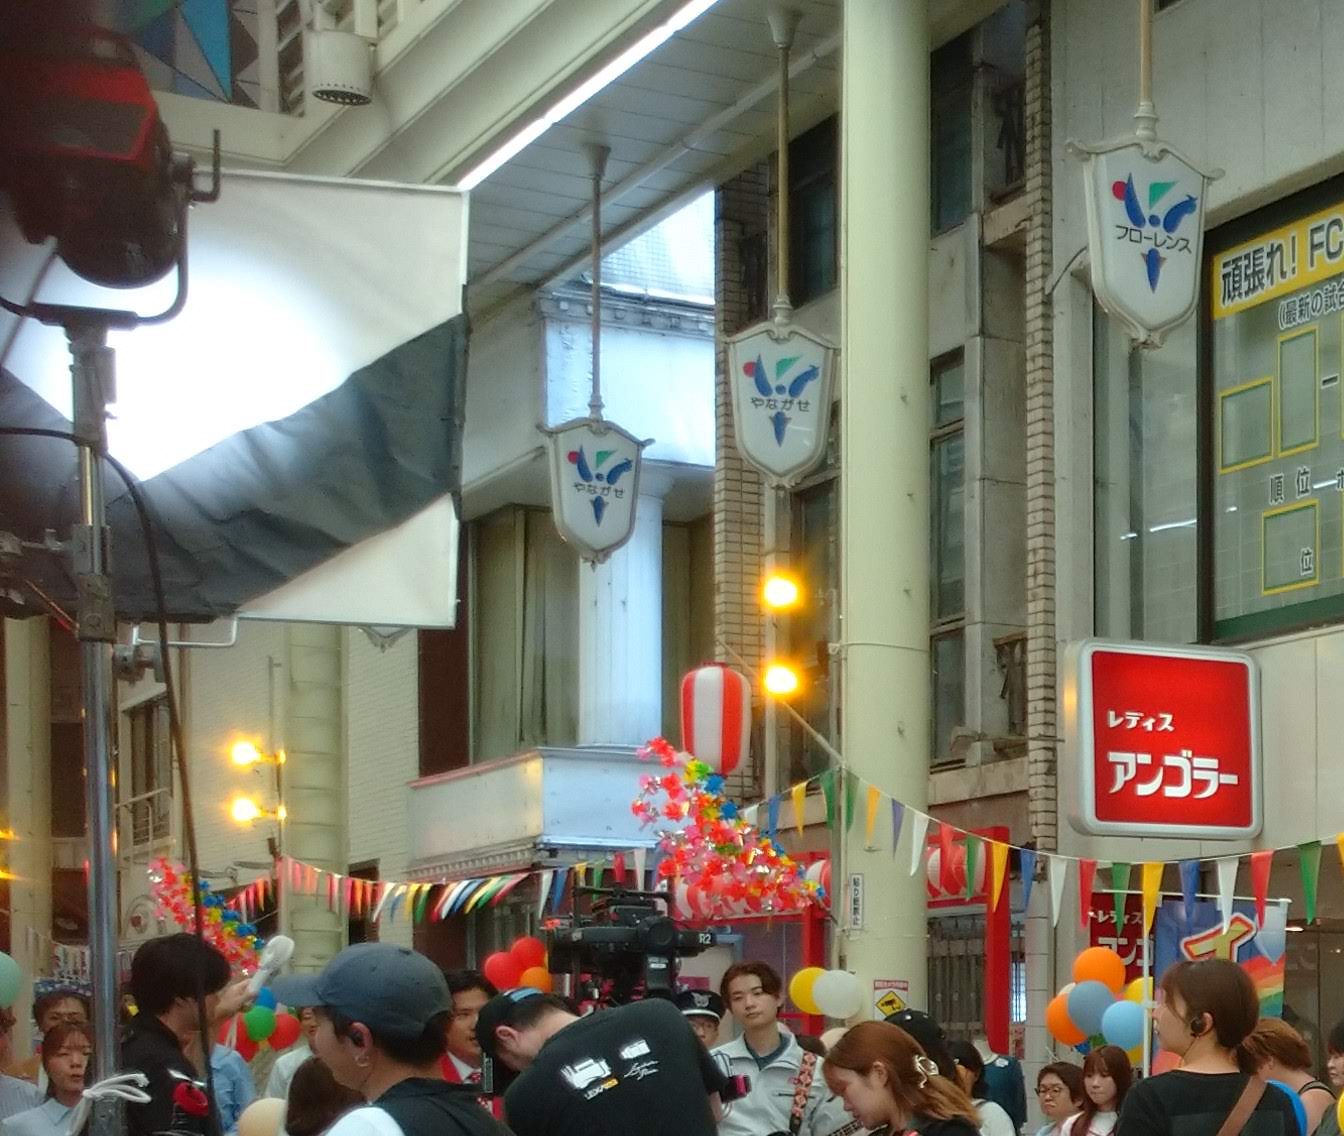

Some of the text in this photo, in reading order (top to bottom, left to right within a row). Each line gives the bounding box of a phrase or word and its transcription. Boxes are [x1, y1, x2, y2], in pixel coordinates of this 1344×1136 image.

[1115, 225, 1192, 254] フローレンス
[751, 397, 810, 412] やながせ
[573, 483, 625, 498] やながせ
[1108, 710, 1174, 731] レディス
[1108, 750, 1239, 798] アンゴラー
